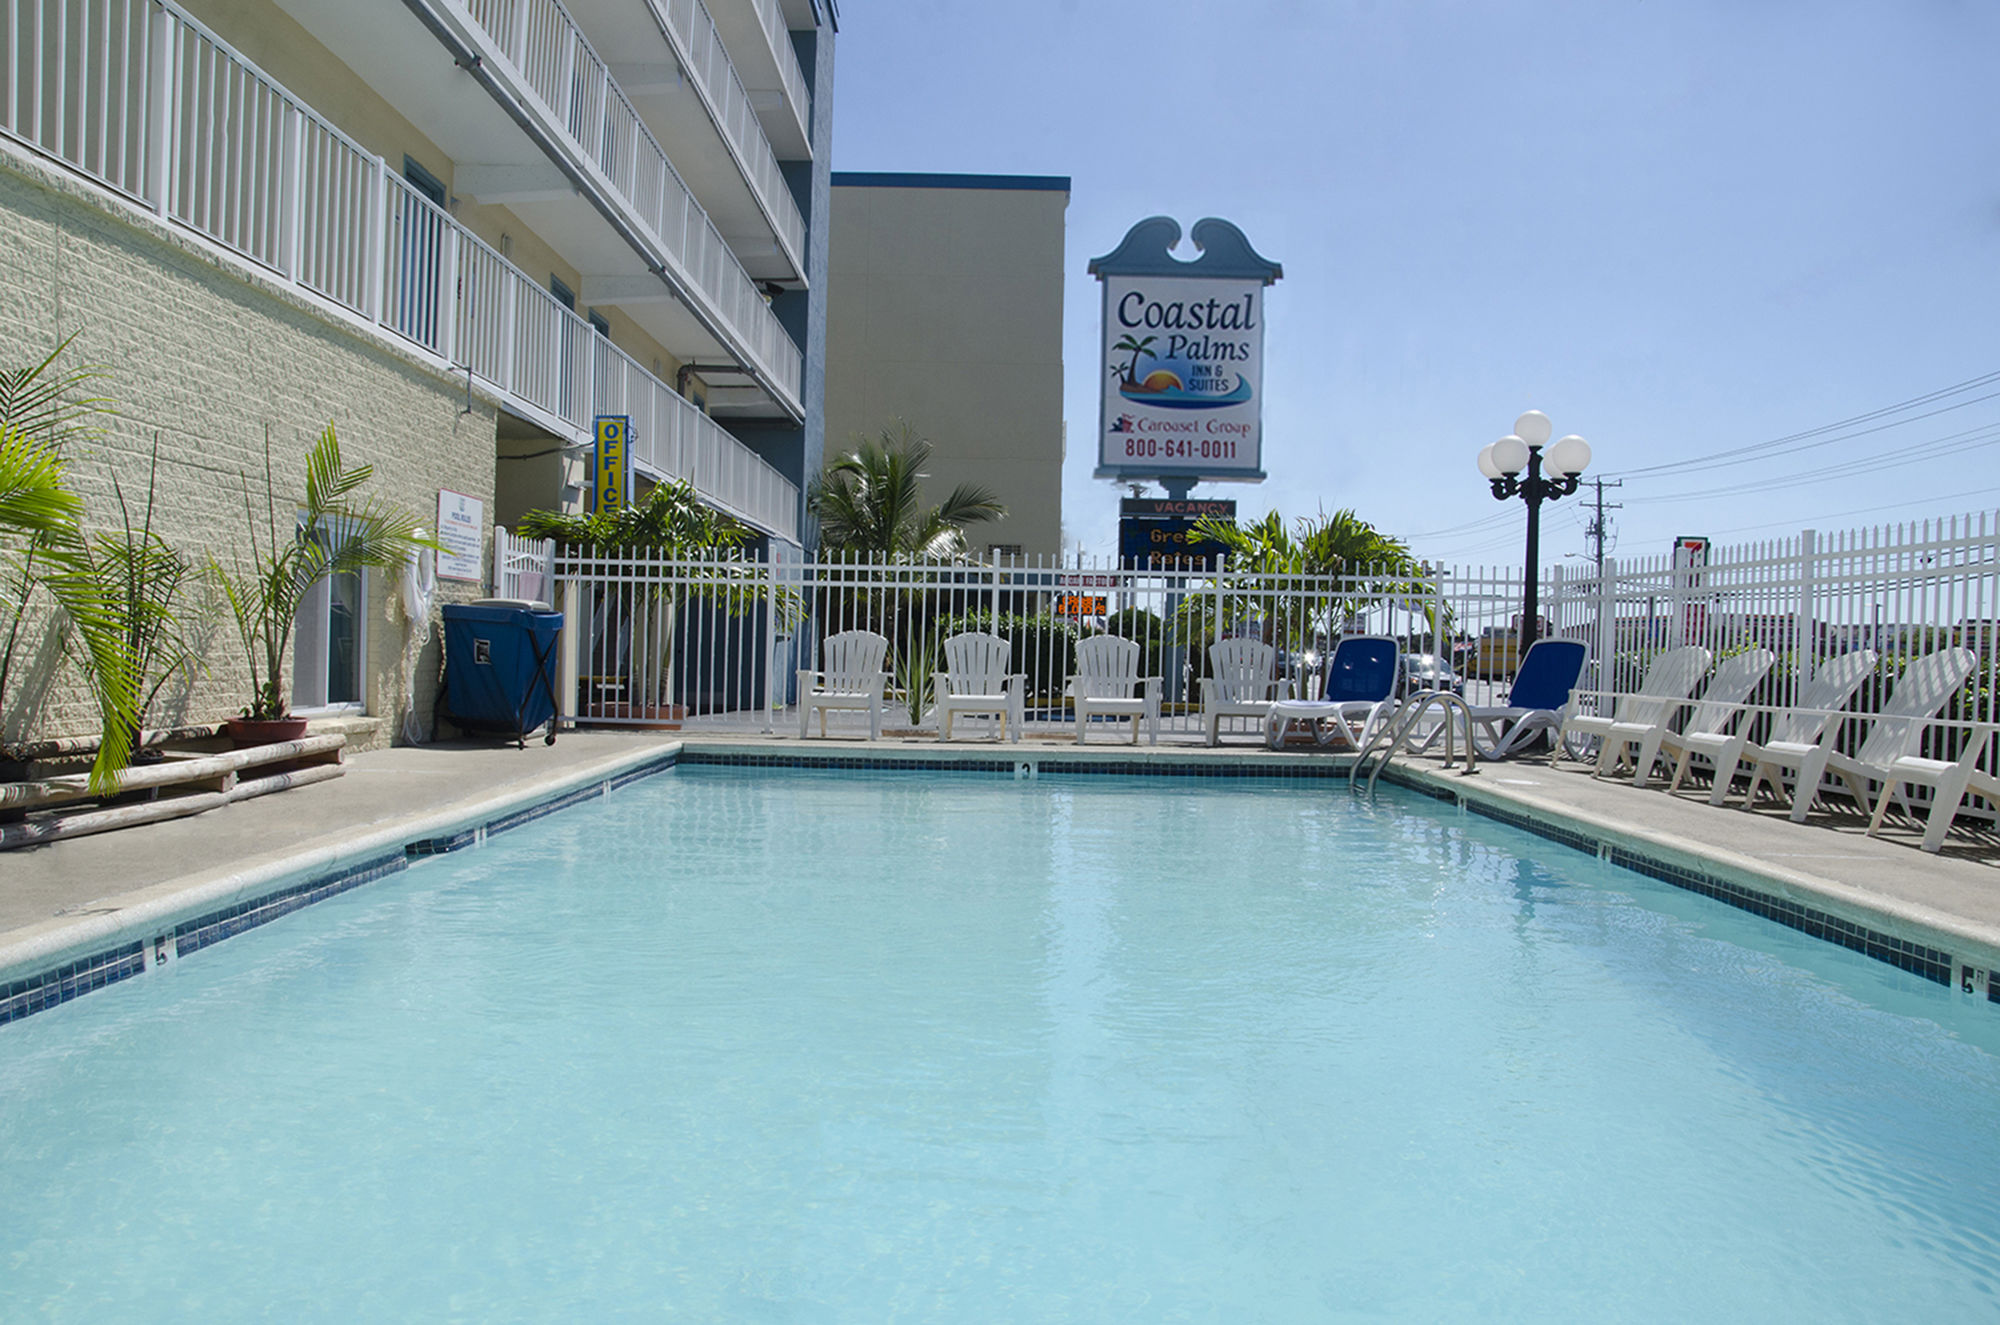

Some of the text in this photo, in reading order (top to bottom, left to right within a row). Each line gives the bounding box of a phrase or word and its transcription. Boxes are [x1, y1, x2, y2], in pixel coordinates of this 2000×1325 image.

[1118, 291, 1255, 330] Coastal
[1165, 334, 1250, 361] Palms
[1192, 364, 1223, 377] INN &
[1188, 378, 1229, 392] SUITES
[1137, 417, 1251, 439] Carousel Group
[1125, 438, 1236, 459] 800-641-0011
[1154, 501, 1229, 513] VACANCY
[154, 935, 168, 966] 5
[1961, 964, 1974, 994] 5
